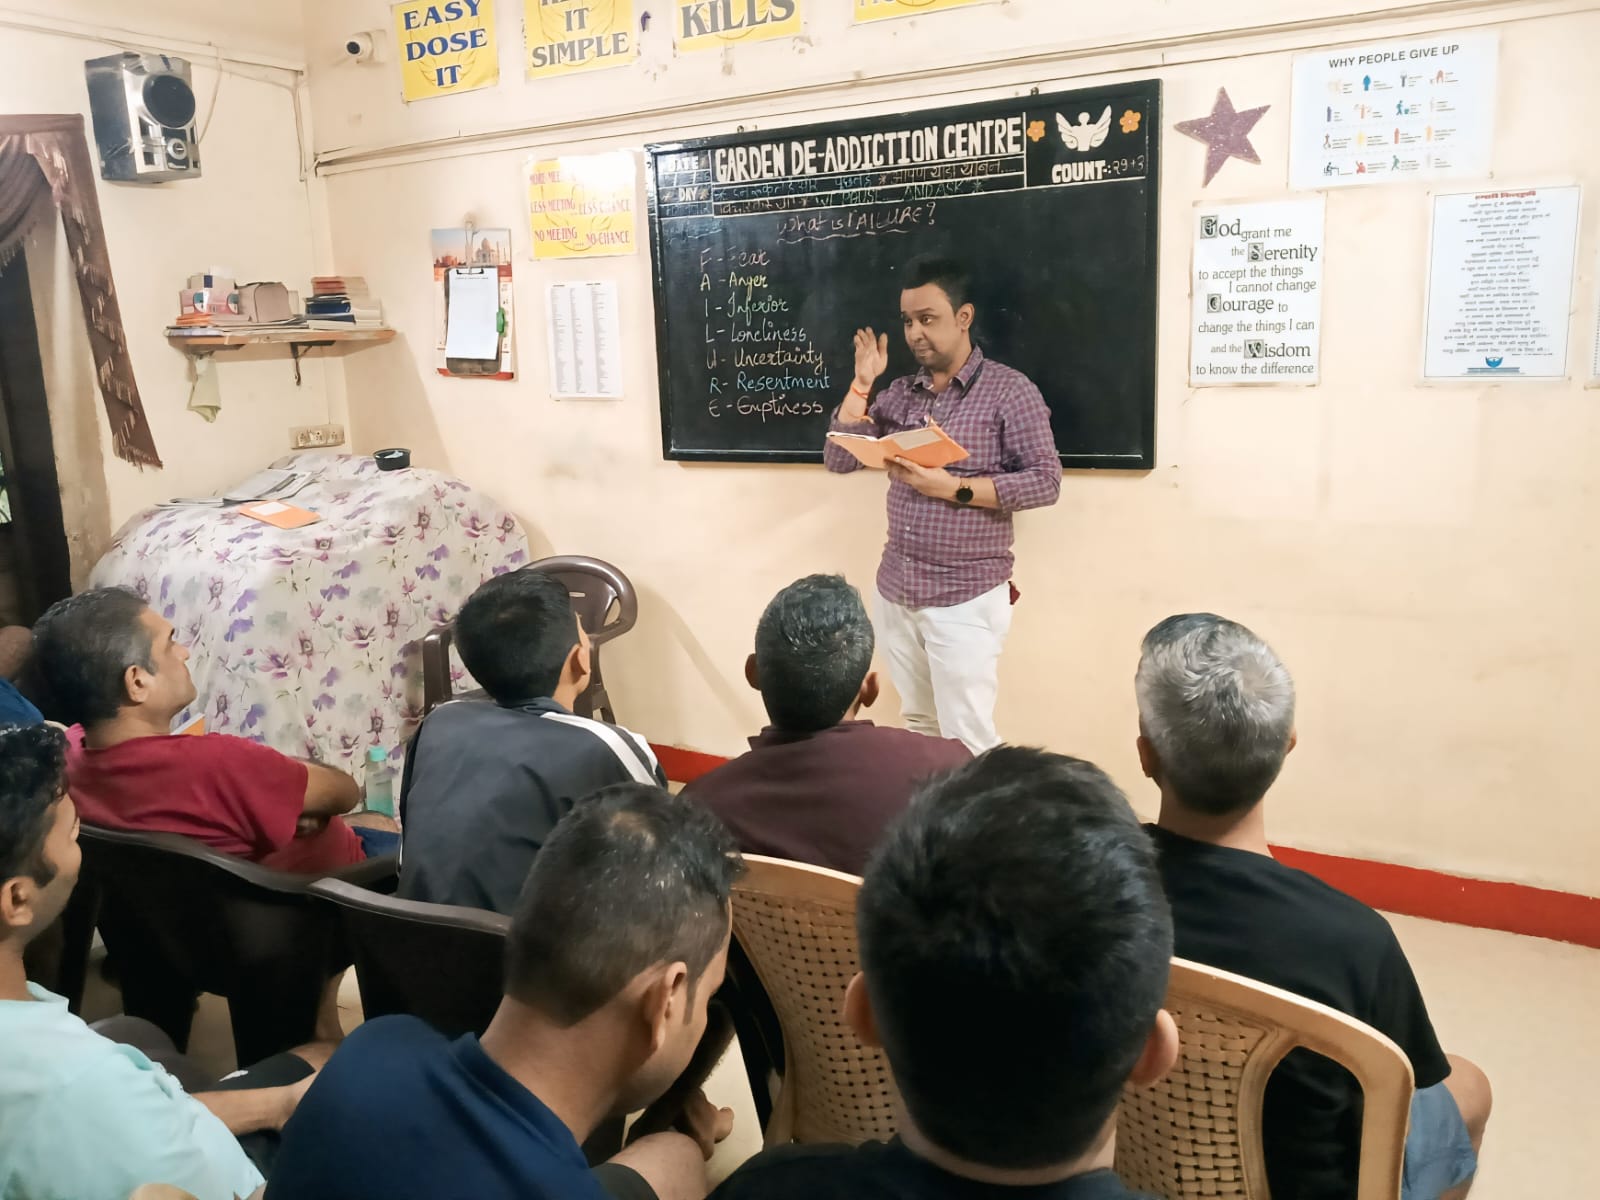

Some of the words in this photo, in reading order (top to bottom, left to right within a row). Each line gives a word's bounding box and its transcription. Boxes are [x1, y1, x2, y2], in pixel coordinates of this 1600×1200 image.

[404, 0, 481, 31] EASY
[565, 7, 590, 32] IT
[681, 0, 796, 38] KILLS
[406, 28, 488, 62] DOSE
[532, 32, 630, 68] SIMPLE
[1328, 56, 1356, 69] WHY
[1358, 51, 1406, 65] PEOPLE
[1409, 47, 1438, 60] GIVE
[1442, 44, 1460, 56] UP
[436, 64, 462, 87] IT
[715, 142, 786, 183] GARDEN
[791, 126, 938, 176] DE-ADDICTION
[943, 117, 1022, 159] CENTRE
[678, 187, 699, 201] DAY
[546, 227, 577, 241] MEETING
[1200, 214, 1241, 240] God
[1241, 227, 1270, 242] grant
[1273, 227, 1292, 238] me
[1231, 246, 1245, 257] the
[1247, 242, 1318, 262] Serenity
[1198, 269, 1209, 280] to
[1212, 268, 1247, 282] accept
[1250, 265, 1267, 278] the
[1270, 264, 1304, 279] things
[1235, 280, 1273, 293] cannot
[1276, 279, 1317, 294] change
[1206, 293, 1275, 314] Courage
[1278, 302, 1288, 313] to
[1198, 321, 1234, 335] change
[1236, 320, 1253, 332] the
[1255, 319, 1286, 334] things
[1296, 320, 1315, 331] can
[734, 341, 824, 375] Uncertainty
[1210, 343, 1227, 353] and
[1229, 343, 1243, 353] the
[1243, 338, 1312, 359] Wisdom
[736, 367, 831, 392] Resentment
[1196, 364, 1207, 375] to
[1209, 363, 1239, 375] know
[1241, 362, 1258, 374] the
[1260, 361, 1315, 375] difference
